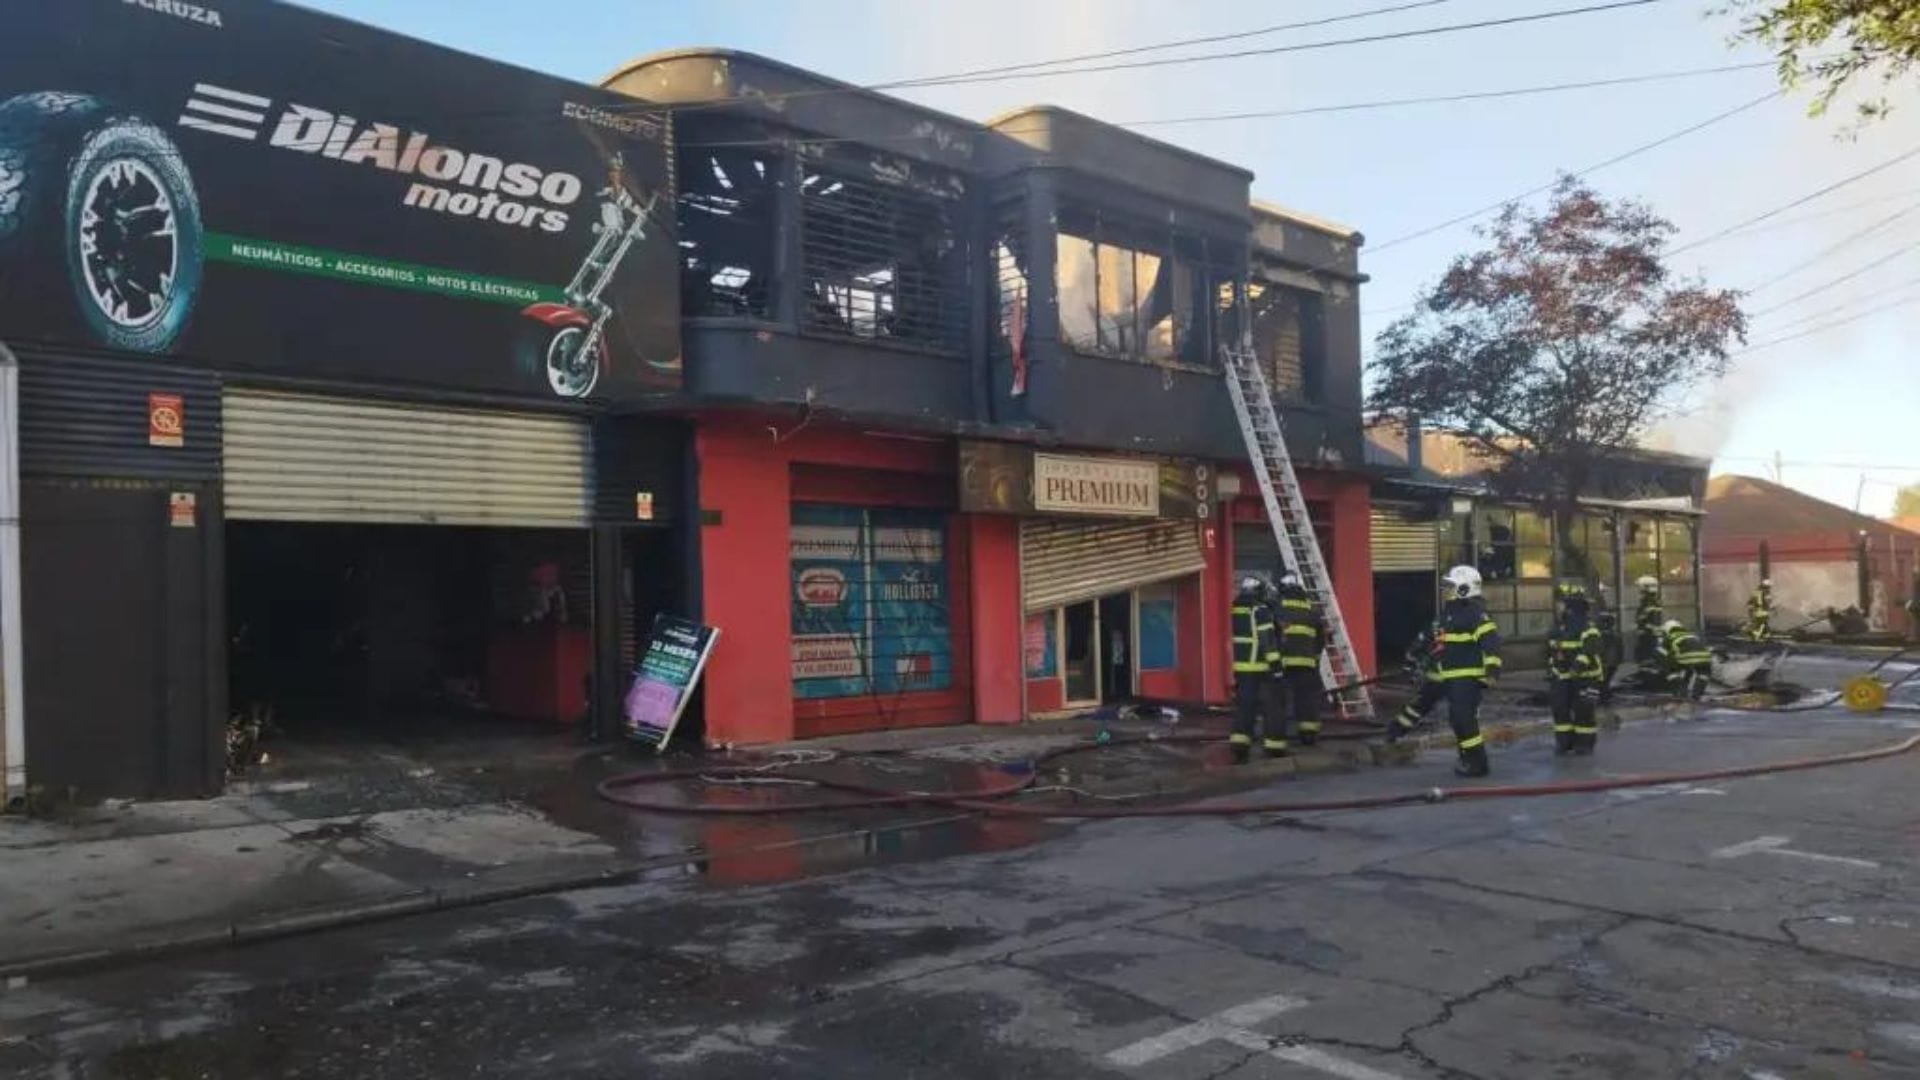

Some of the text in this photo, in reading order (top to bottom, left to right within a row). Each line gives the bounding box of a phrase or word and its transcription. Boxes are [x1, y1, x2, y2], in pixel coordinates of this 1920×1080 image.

[269, 102, 582, 204] DiAlonso
[403, 182, 569, 232] motors
[231, 243, 323, 268] NEUMÁTICOS
[335, 260, 415, 282] ACCESORIOS
[427, 274, 467, 290] MOTOS
[469, 280, 539, 301] ELÉCTRICAS
[1046, 477, 1149, 507] PREMIUM
